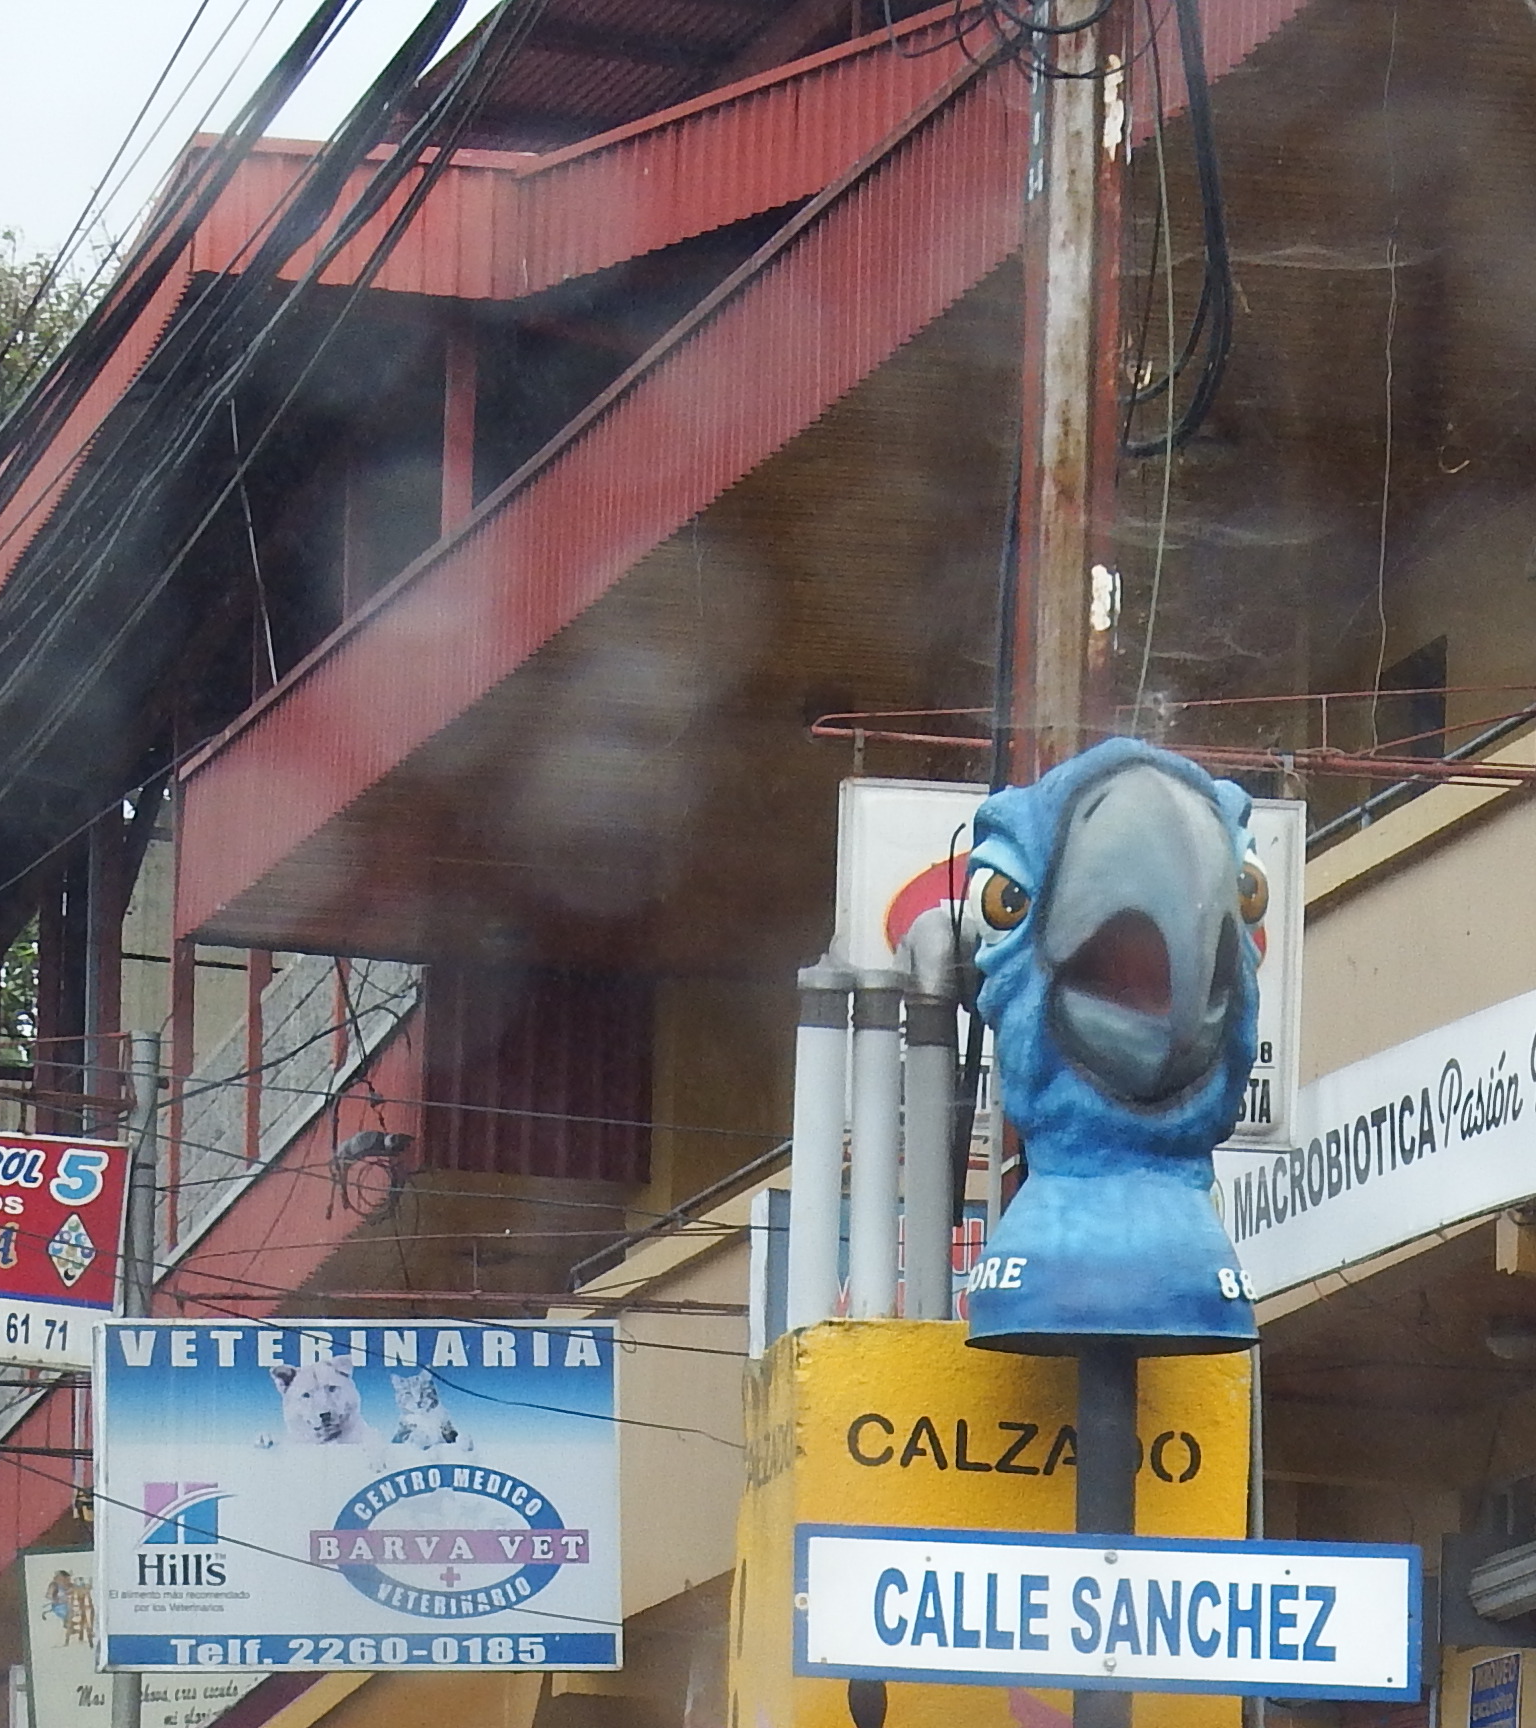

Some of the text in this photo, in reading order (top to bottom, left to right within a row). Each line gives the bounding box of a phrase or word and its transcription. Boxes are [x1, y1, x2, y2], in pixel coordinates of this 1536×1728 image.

[1233, 1087, 1436, 1246] MACROBIOTICA
[1437, 1049, 1524, 1149] Pasión
[50, 1149, 109, 1205] 5
[5, 1312, 31, 1345] 61
[44, 1319, 69, 1352] 71
[119, 1329, 602, 1368] VETERINARIA
[846, 1412, 1203, 1485] CALZAO
[353, 1467, 543, 1521] CENTRO MEDICO
[317, 1535, 585, 1561] BARVA VET
[137, 1552, 227, 1587] Hill's
[375, 1576, 532, 1616] VETERINARIO
[873, 1566, 1338, 1663] CALLE SANCHEZ
[169, 1636, 547, 1667] Telf. 2260-0185
